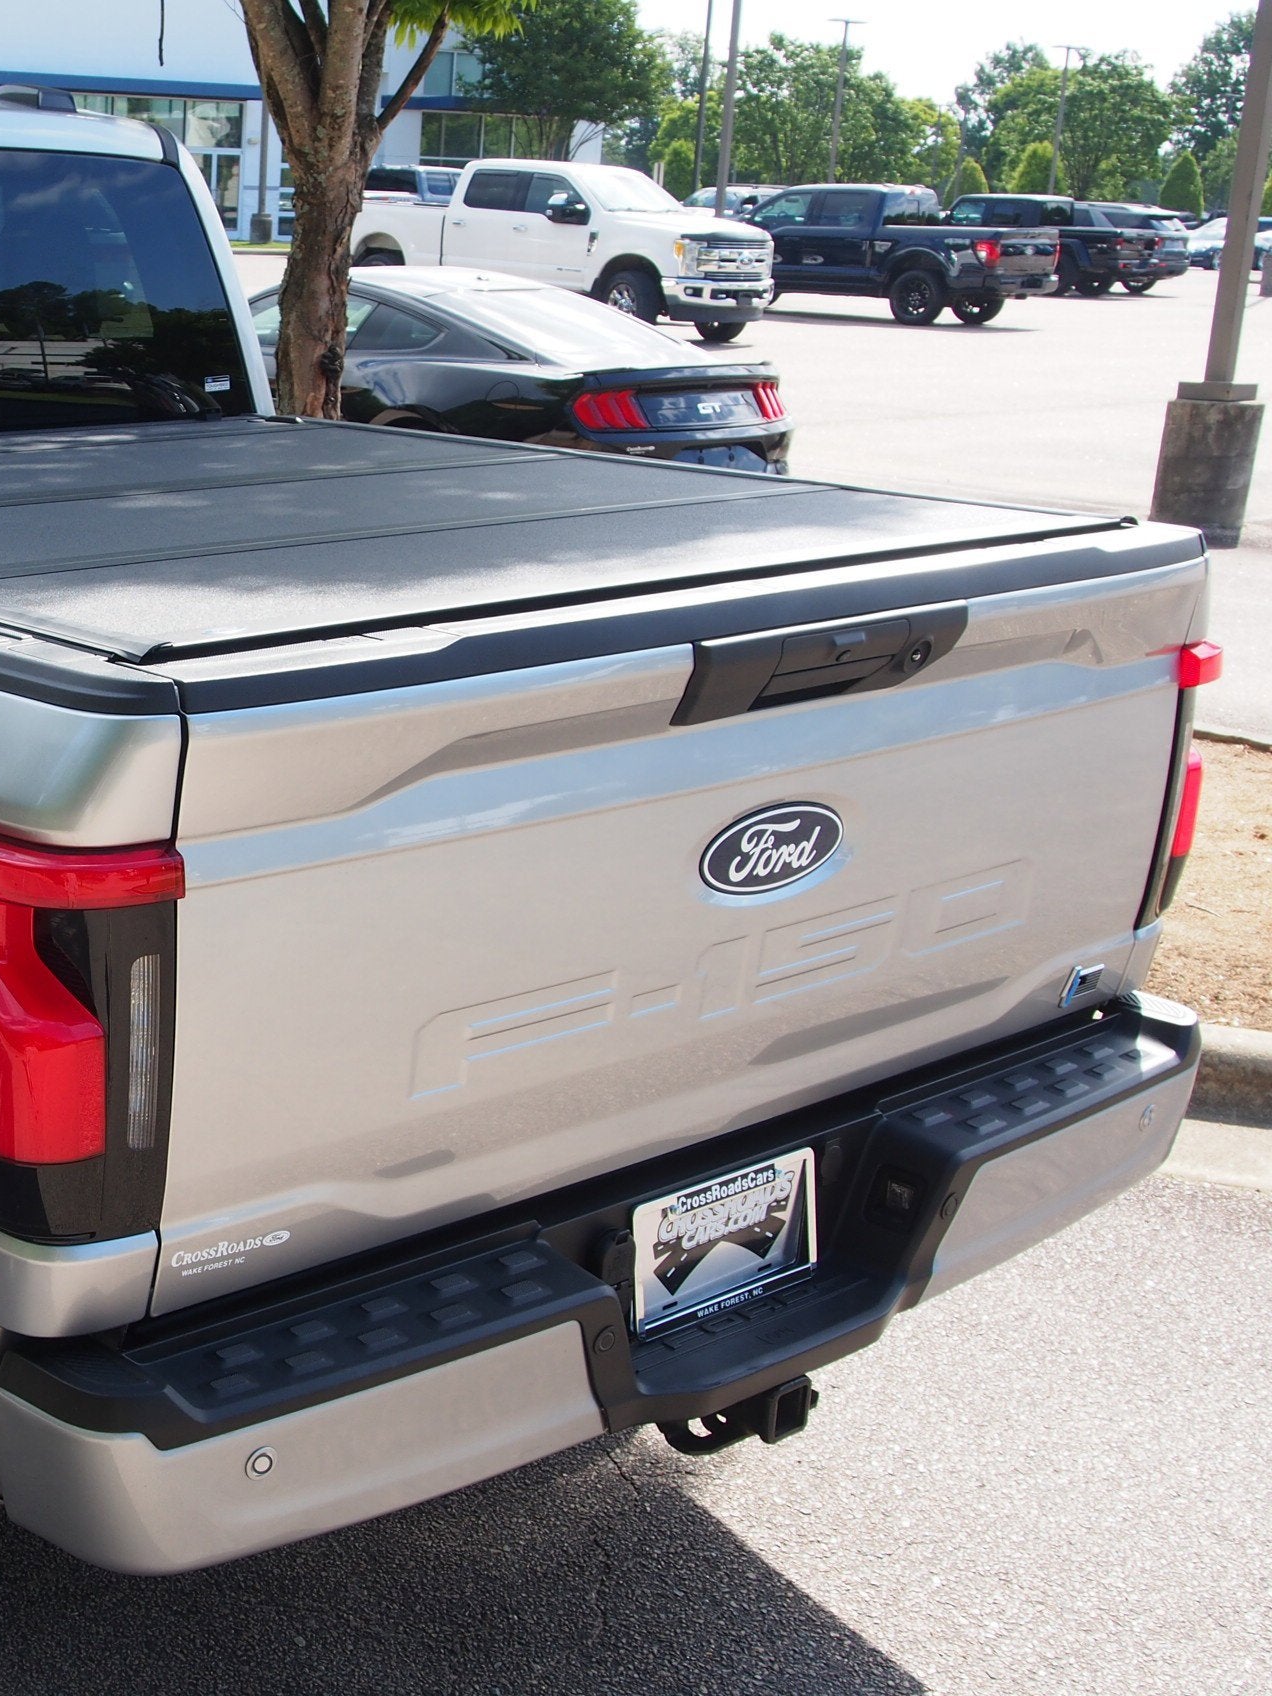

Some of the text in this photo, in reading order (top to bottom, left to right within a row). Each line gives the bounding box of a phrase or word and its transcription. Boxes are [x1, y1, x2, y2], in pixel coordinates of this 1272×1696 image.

[697, 402, 722, 414] GT
[728, 818, 821, 883] Ford
[678, 1168, 775, 1214] CrossRoadsCars
[181, 1256, 246, 1277] WAKE FOREST NC
[697, 1304, 719, 1318] WAKE
[752, 1287, 764, 1297] NC
